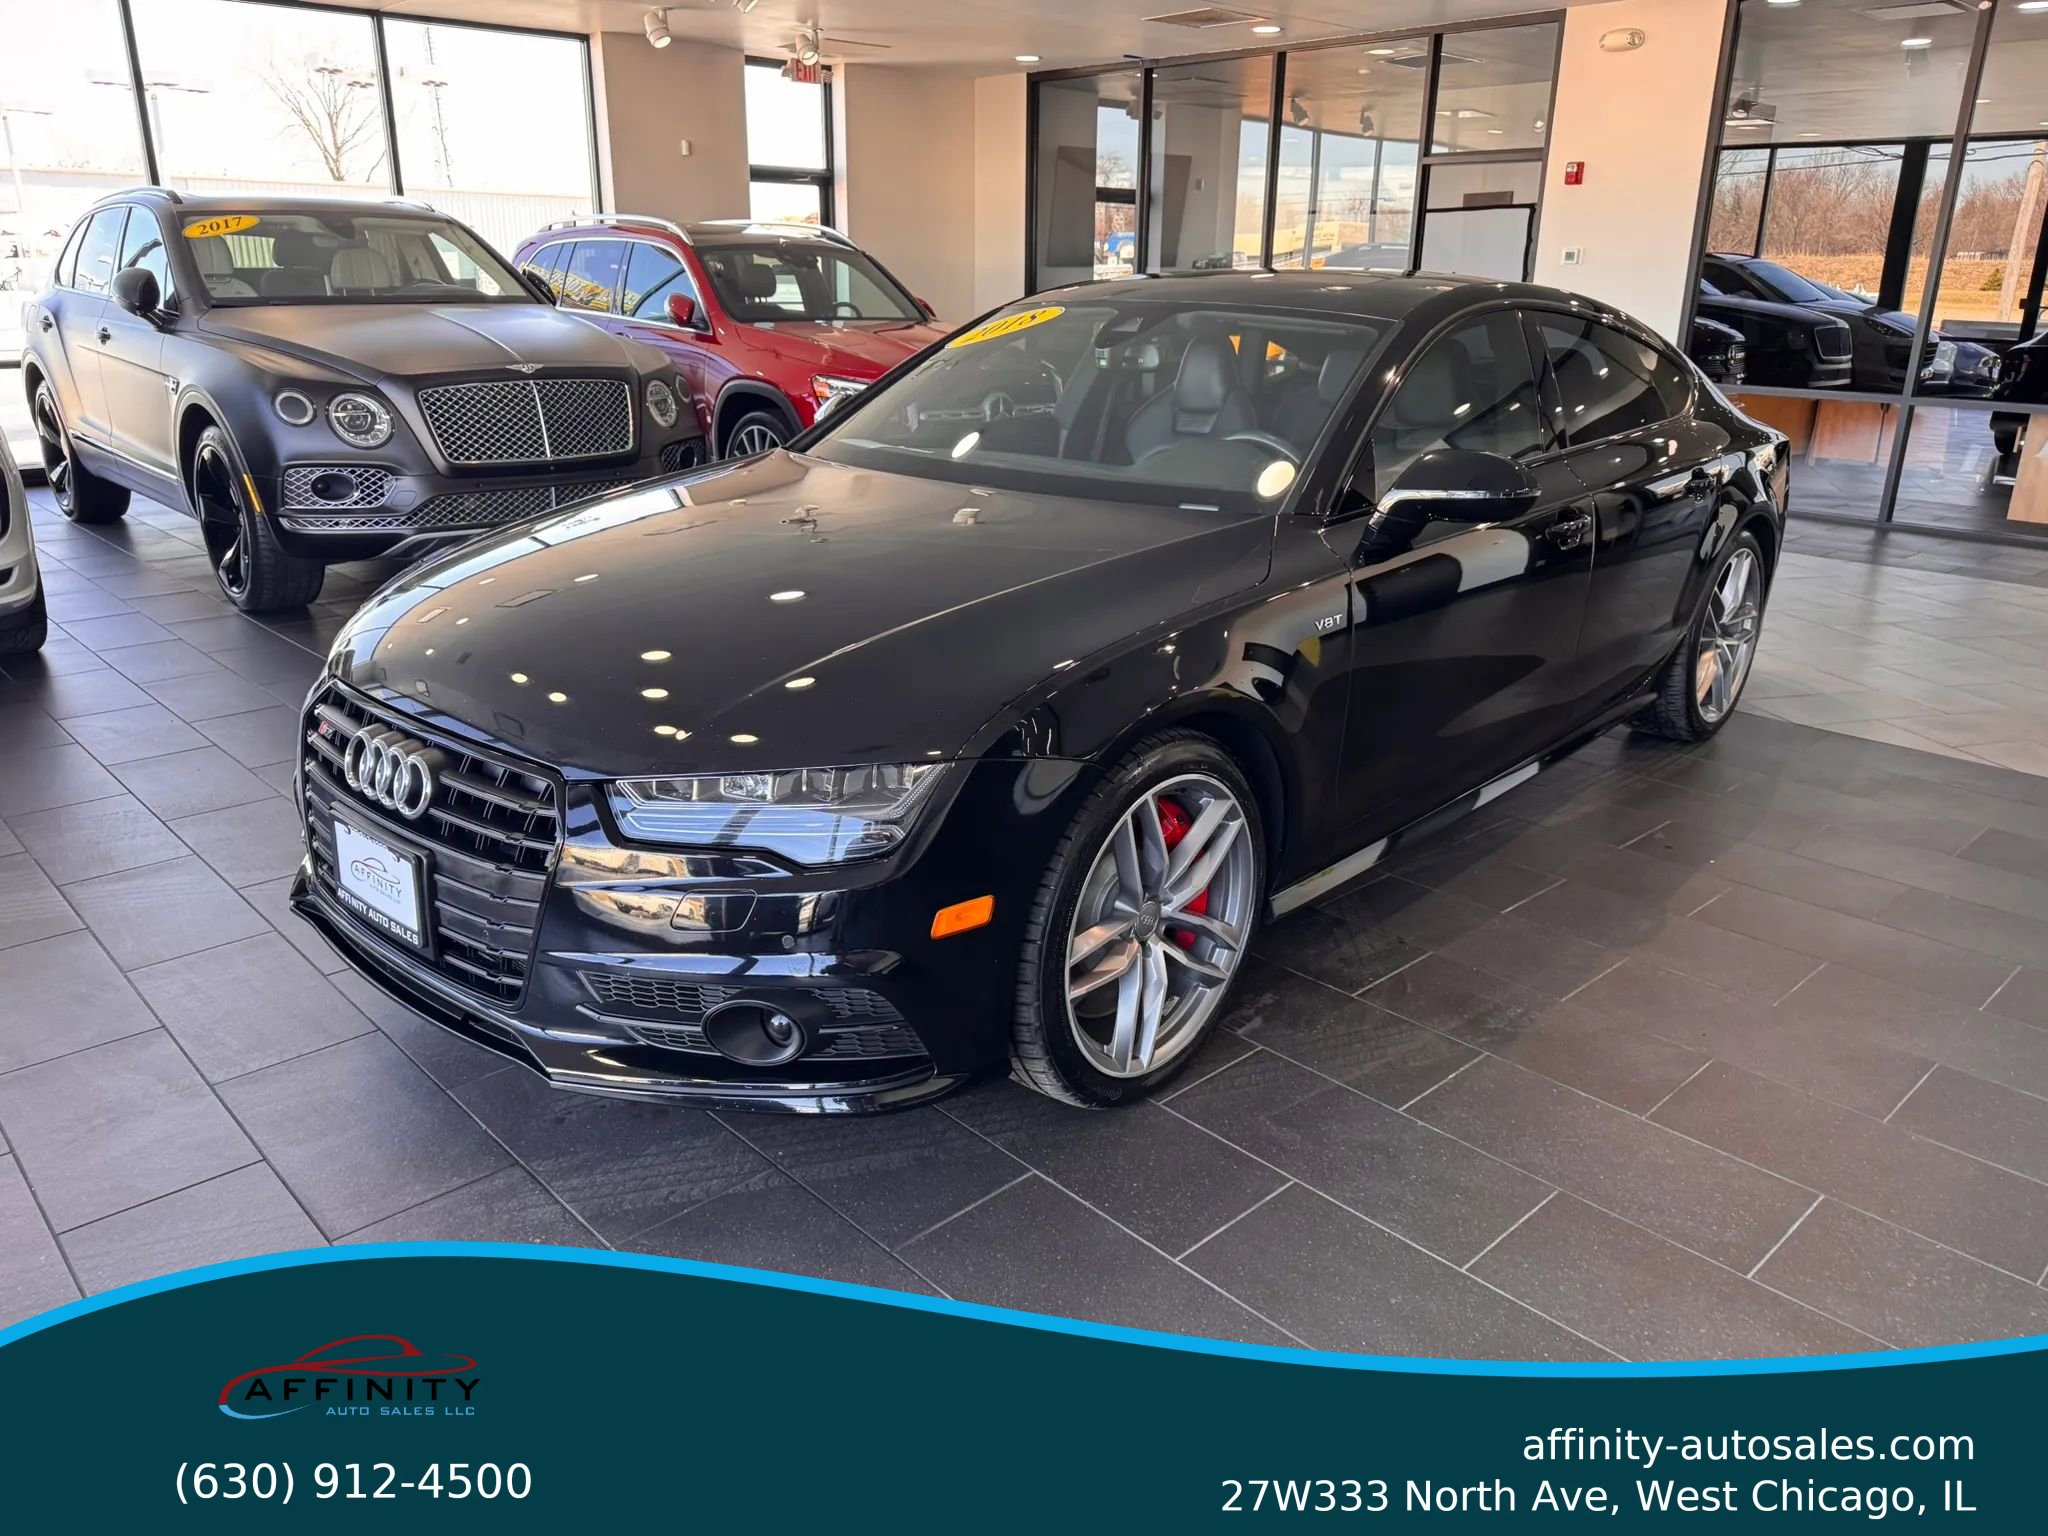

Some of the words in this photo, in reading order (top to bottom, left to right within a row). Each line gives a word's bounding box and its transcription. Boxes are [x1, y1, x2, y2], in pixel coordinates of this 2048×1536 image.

[197, 216, 242, 235] 2017
[1315, 613, 1343, 631] V8T
[354, 864, 402, 898] AFFINITY
[337, 887, 368, 915] AFFINITY
[368, 908, 389, 929] AUTO
[390, 921, 419, 945] SALES
